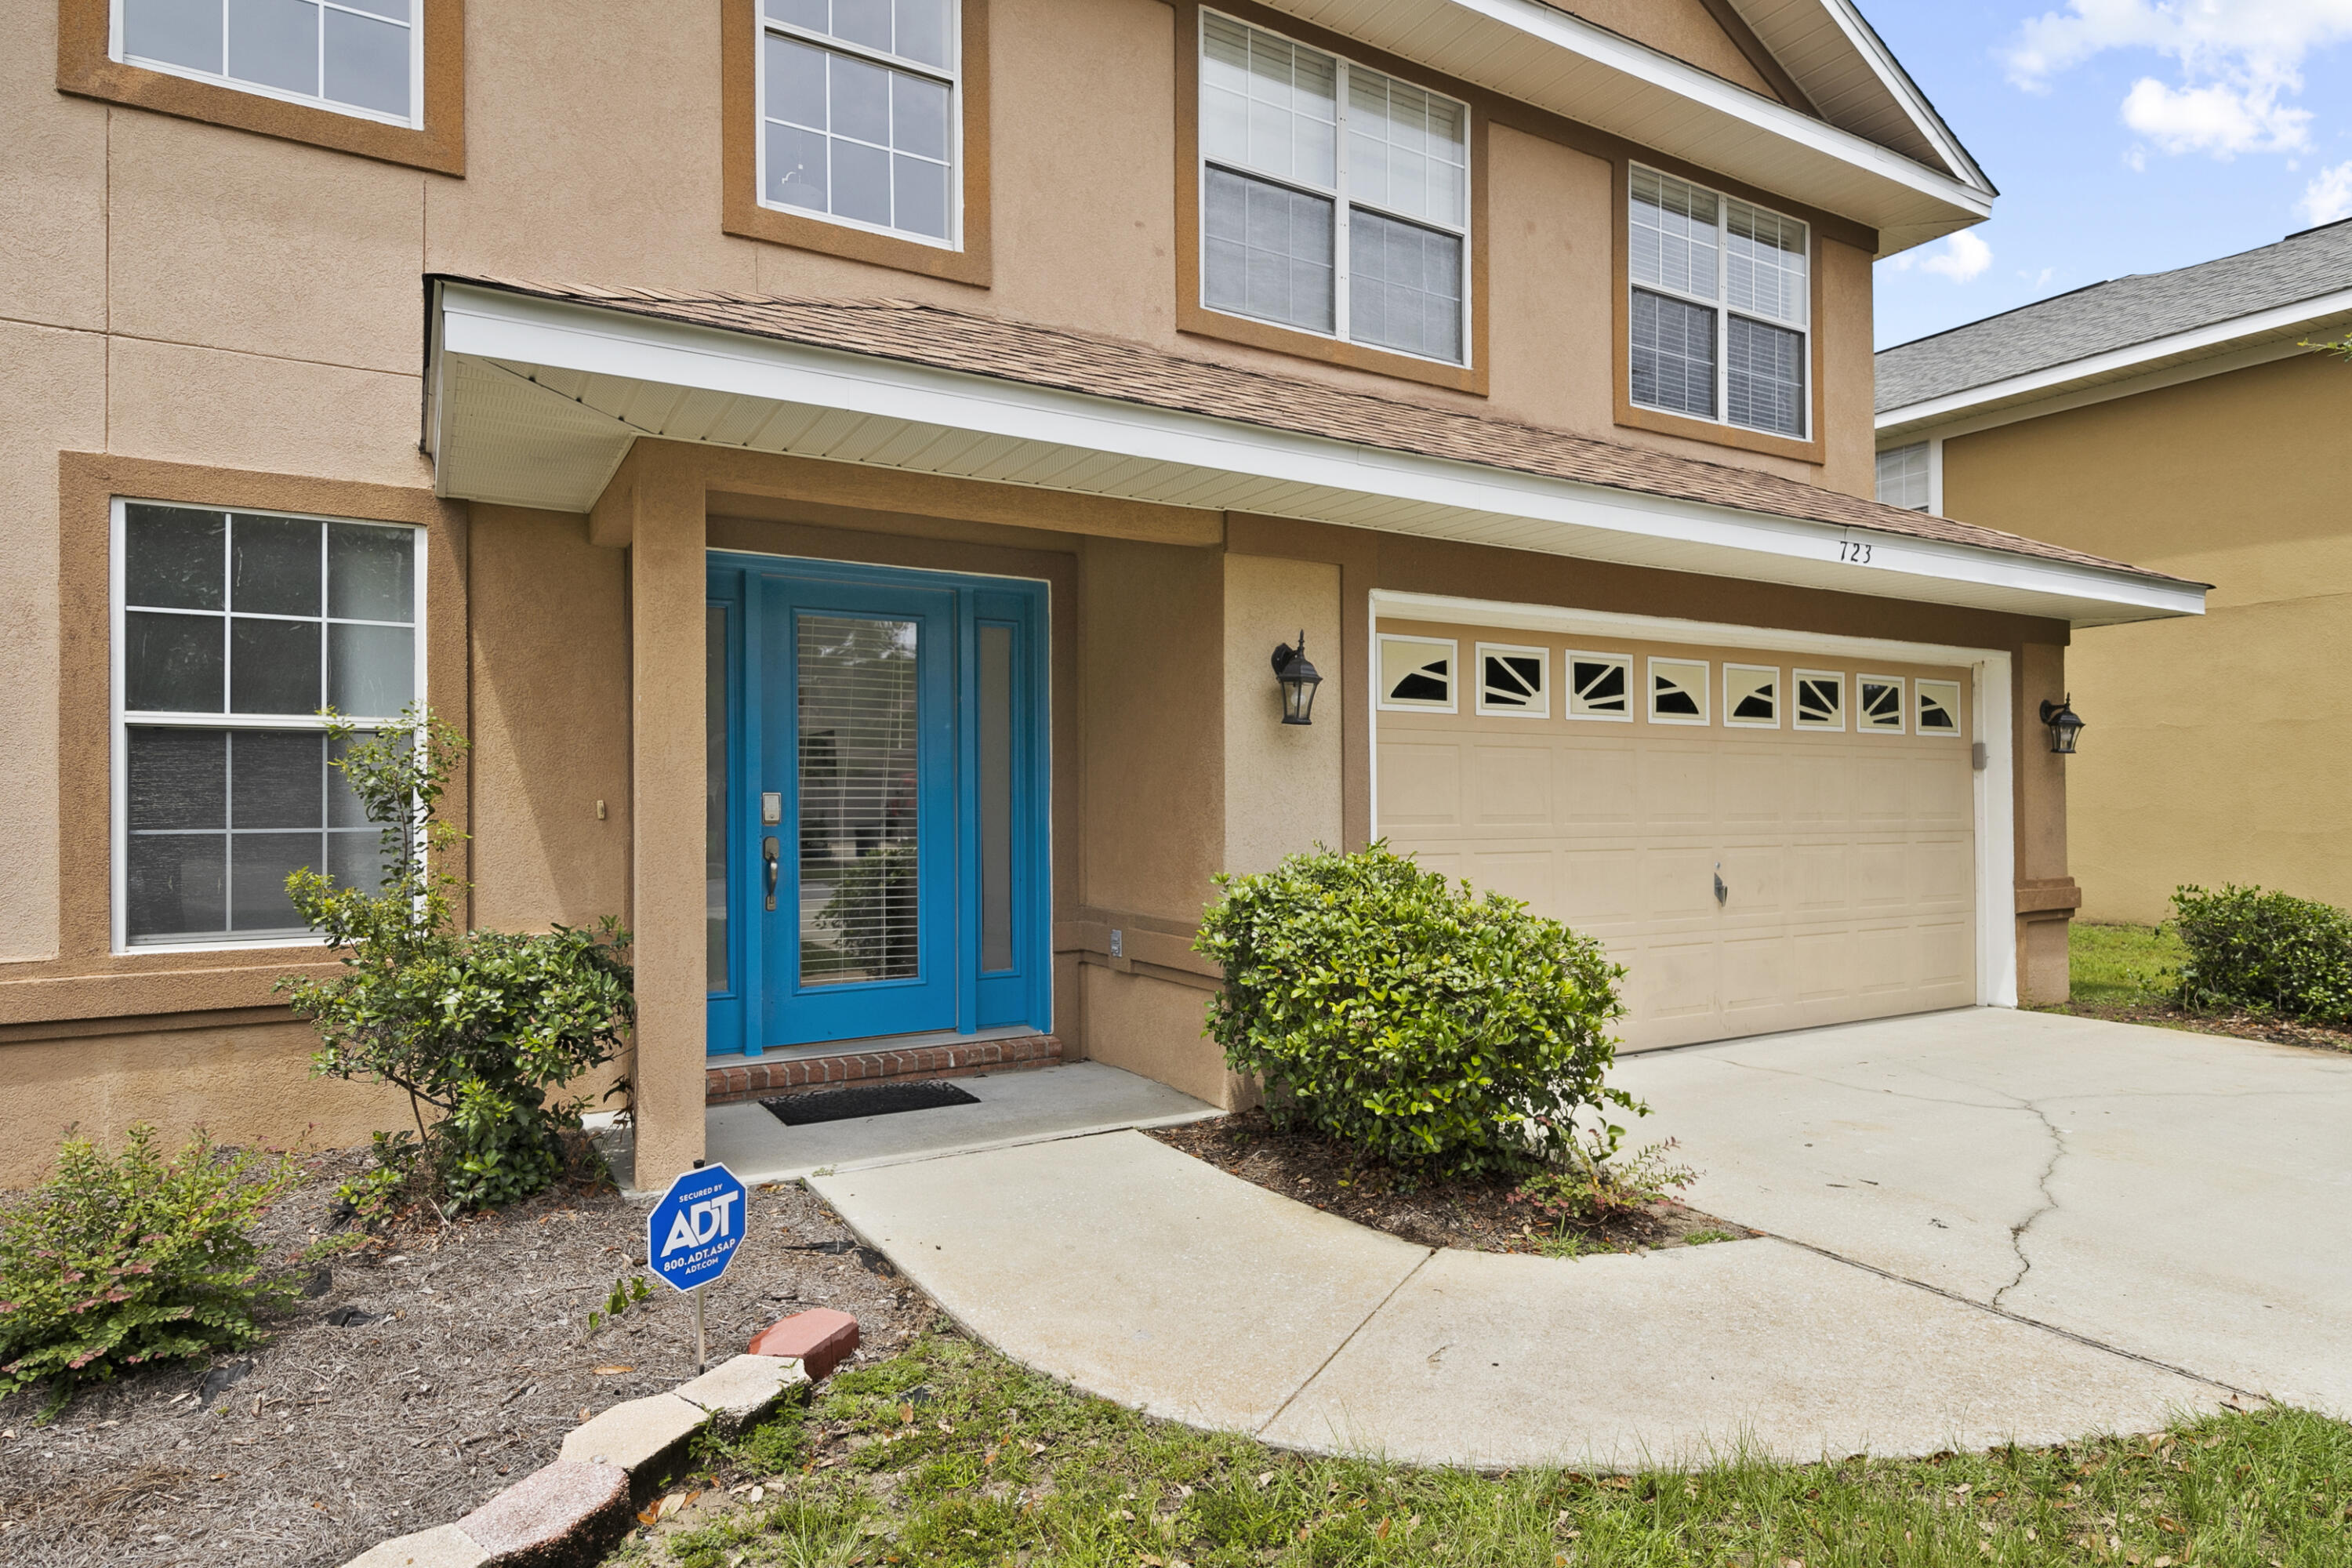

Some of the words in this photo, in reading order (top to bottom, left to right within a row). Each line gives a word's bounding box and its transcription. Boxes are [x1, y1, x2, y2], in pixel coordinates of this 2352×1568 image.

[1840, 541, 1871, 564] 723
[679, 1187, 713, 1203] SECURED
[714, 1183, 723, 1192] BY
[660, 1190, 739, 1258] ADT
[663, 1238, 736, 1272] 800.ADT.ASAP
[685, 1258, 719, 1275] ADT.COM
